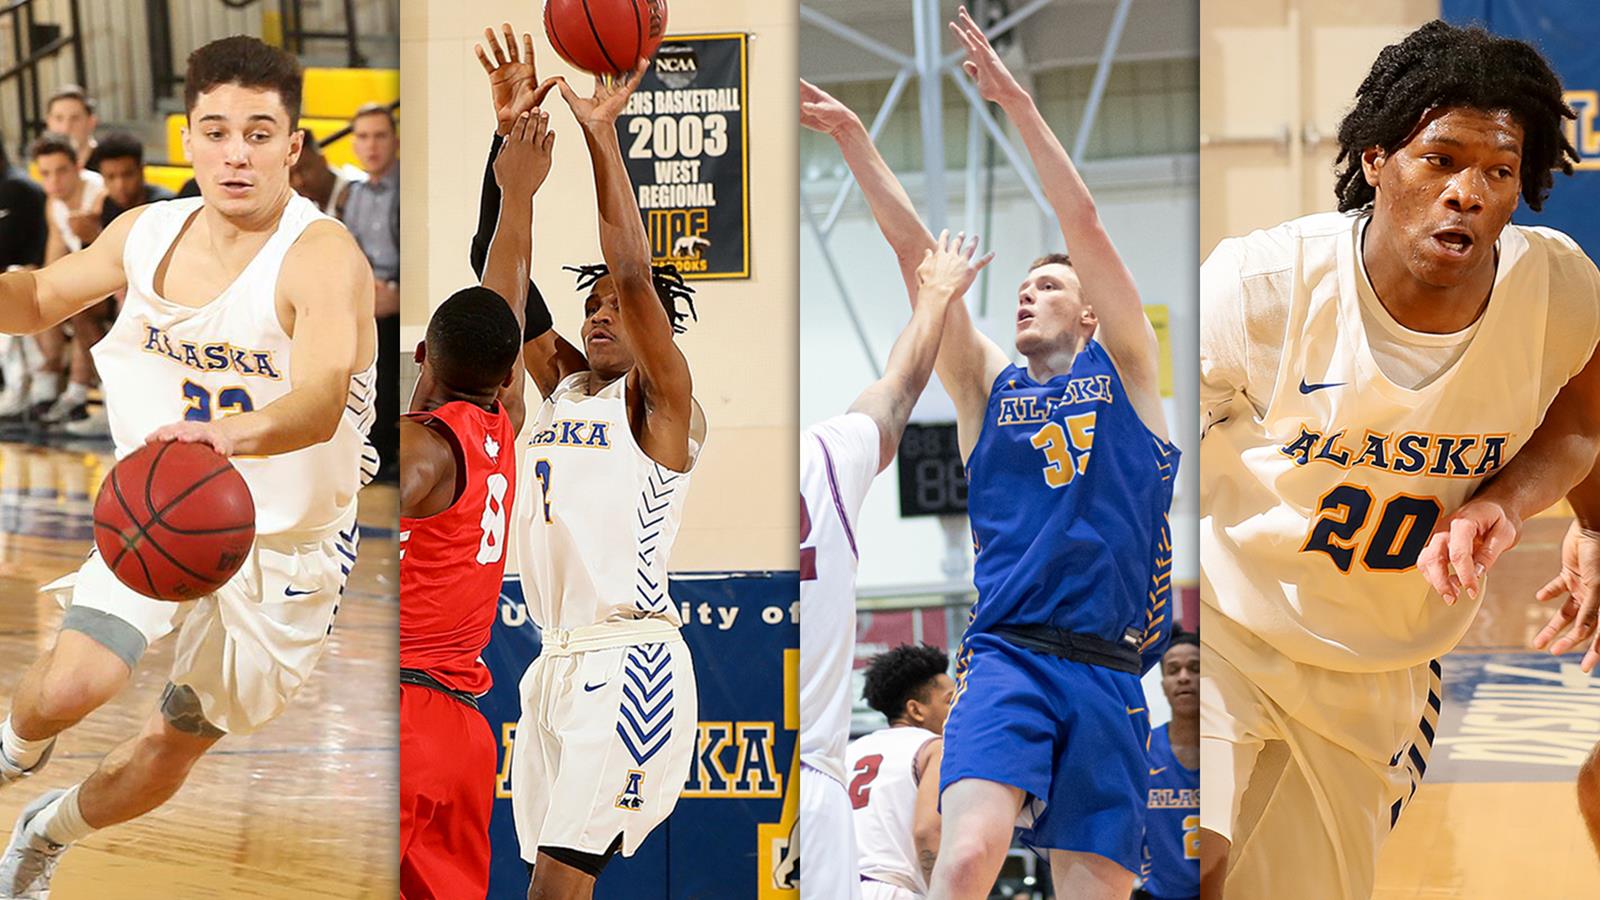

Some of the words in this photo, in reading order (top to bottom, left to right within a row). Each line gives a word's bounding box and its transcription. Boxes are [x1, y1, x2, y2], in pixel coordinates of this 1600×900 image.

[655, 57, 697, 72] NCAA
[621, 91, 654, 115] ENS
[654, 87, 740, 114] BASKETBALL
[628, 114, 728, 159] 2003
[639, 183, 716, 208] REGIONAL
[654, 160, 700, 184] WEST
[649, 208, 708, 260] UAF
[142, 323, 283, 380] ALASKA
[1030, 411, 1097, 489] 35
[1279, 423, 1509, 479] ALASKA
[476, 473, 508, 565] 8
[1298, 482, 1444, 574] 20
[848, 753, 884, 810] 2
